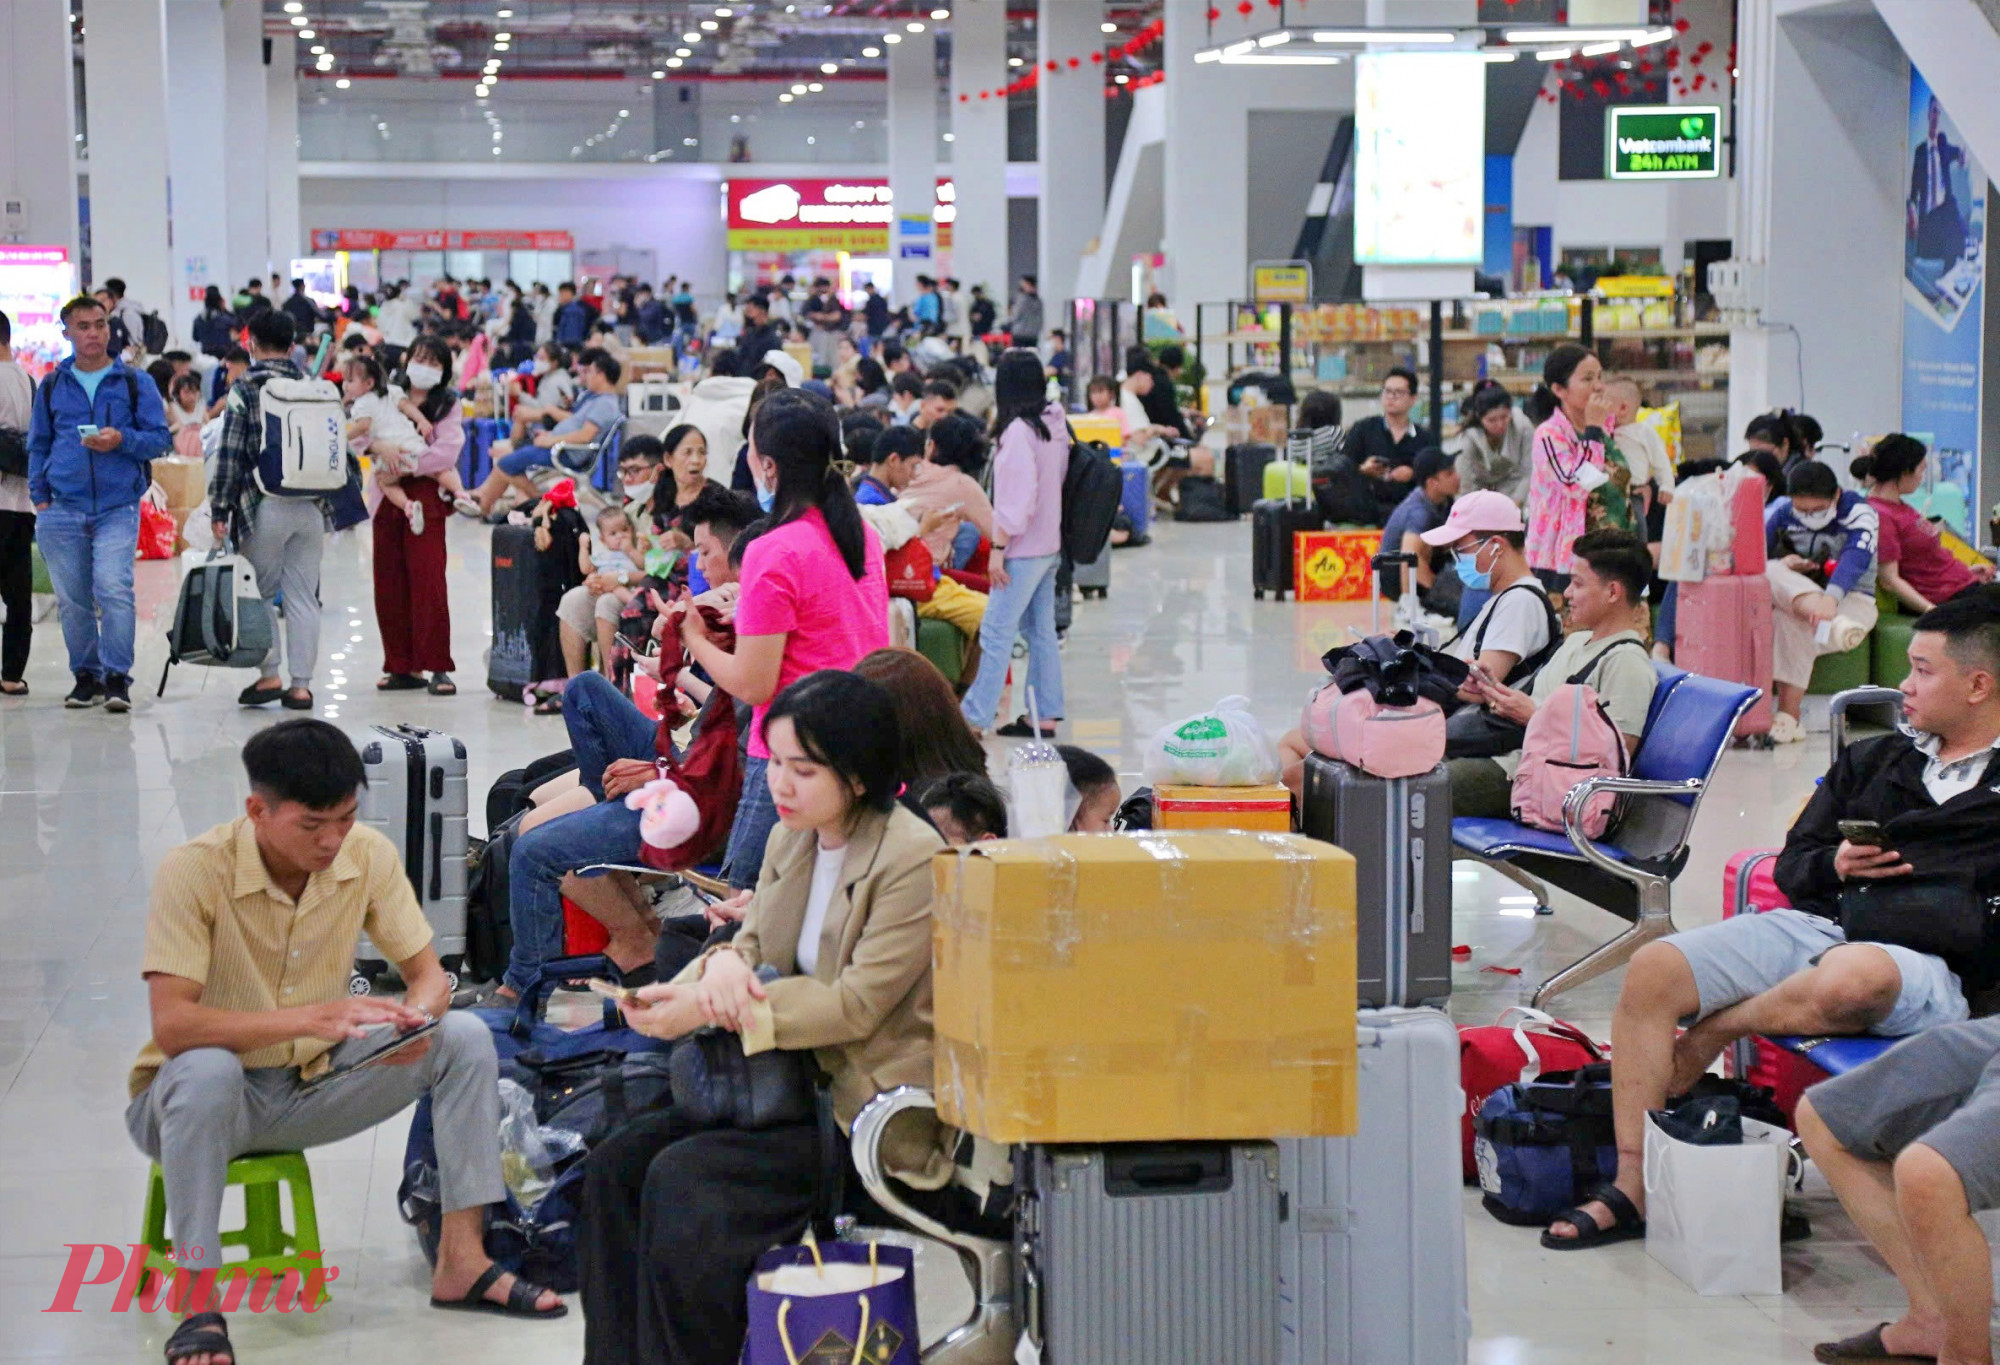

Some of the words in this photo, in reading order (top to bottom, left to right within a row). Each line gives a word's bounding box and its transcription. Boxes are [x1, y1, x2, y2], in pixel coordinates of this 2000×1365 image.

[1619, 136, 1712, 154] Vietcombank
[1630, 153, 1663, 171] 24h
[1665, 153, 1699, 170] ATM
[328, 439, 340, 471] YONEX
[1315, 555, 1337, 572] An
